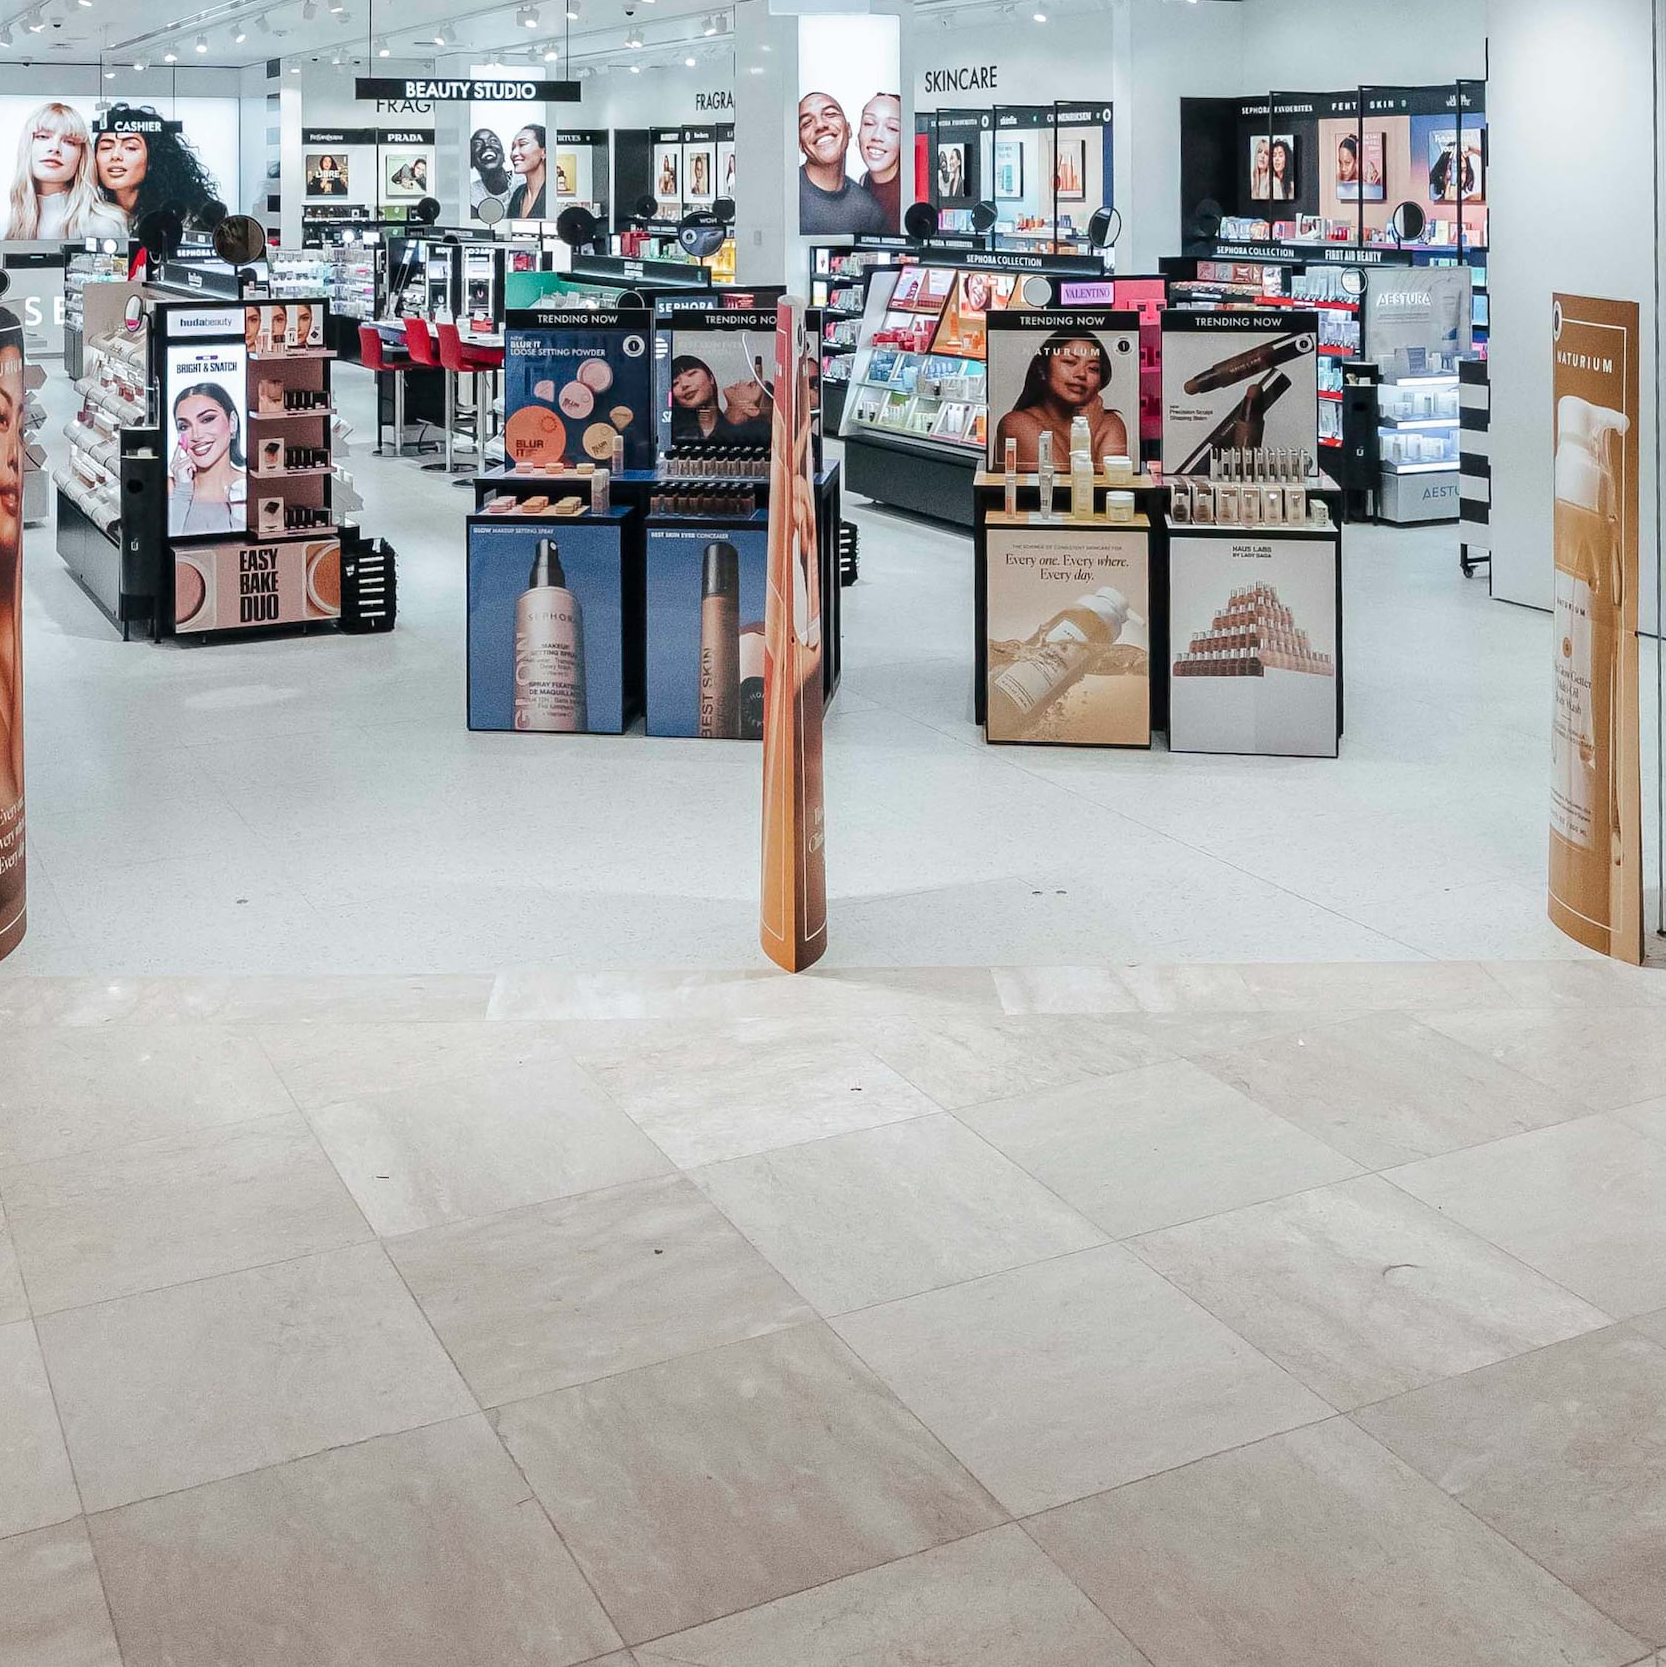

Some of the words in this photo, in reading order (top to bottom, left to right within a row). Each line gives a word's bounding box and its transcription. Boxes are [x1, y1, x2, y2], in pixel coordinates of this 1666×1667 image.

[924, 65, 998, 93] SKINCARE
[405, 80, 471, 98] BEAUTY
[473, 82, 537, 100] STUDIO
[695, 90, 735, 112] FRAGRA
[1331, 102, 1359, 111] FENT
[114, 120, 162, 133] CASHIER
[387, 133, 424, 142] PRADA
[177, 248, 211, 258] SEPHORA
[1217, 245, 1249, 256] SEPHORA
[1249, 246, 1295, 258] COLLECTION
[967, 254, 996, 265] SEPHORA
[996, 256, 1043, 267] COLLECTION
[1063, 288, 1111, 300] VALENTINO
[1376, 292, 1432, 307] AESTURA
[180, 317, 233, 327] hudabeauty
[537, 314, 589, 324] TRENDING
[590, 315, 619, 324] NOW
[705, 315, 758, 325] TRENDING
[760, 316, 777, 325] NO
[1019, 316, 1074, 326] TRENDING
[1077, 316, 1106, 326] NOW
[1195, 317, 1250, 327] TRENDING
[1253, 318, 1283, 327] NOW
[510, 340, 532, 348] BLUR
[510, 348, 537, 356] LOOSE
[537, 348, 571, 356] SETTING
[572, 349, 606, 357] POWDER
[176, 362, 202, 374] BRIGHT
[203, 363, 209, 373] &
[210, 361, 238, 373] SNATCH
[1556, 350, 1613, 375] NATURIUM
[516, 439, 544, 449] BLUR
[516, 448, 526, 457] IT
[1421, 484, 1460, 502] AESTU
[239, 548, 278, 572] EASY
[1005, 553, 1037, 568] Every
[1039, 556, 1061, 566] one.
[1063, 554, 1095, 569] Every
[1097, 555, 1130, 567] where.
[1040, 568, 1072, 583] Every
[1073, 569, 1095, 583] day.
[239, 573, 278, 595] BAKE
[239, 595, 279, 622] DUO
[527, 613, 575, 623] SEPHOR
[702, 647, 713, 688] SKIN
[539, 688, 575, 697] MAQUILLA
[701, 693, 714, 739] BEST
